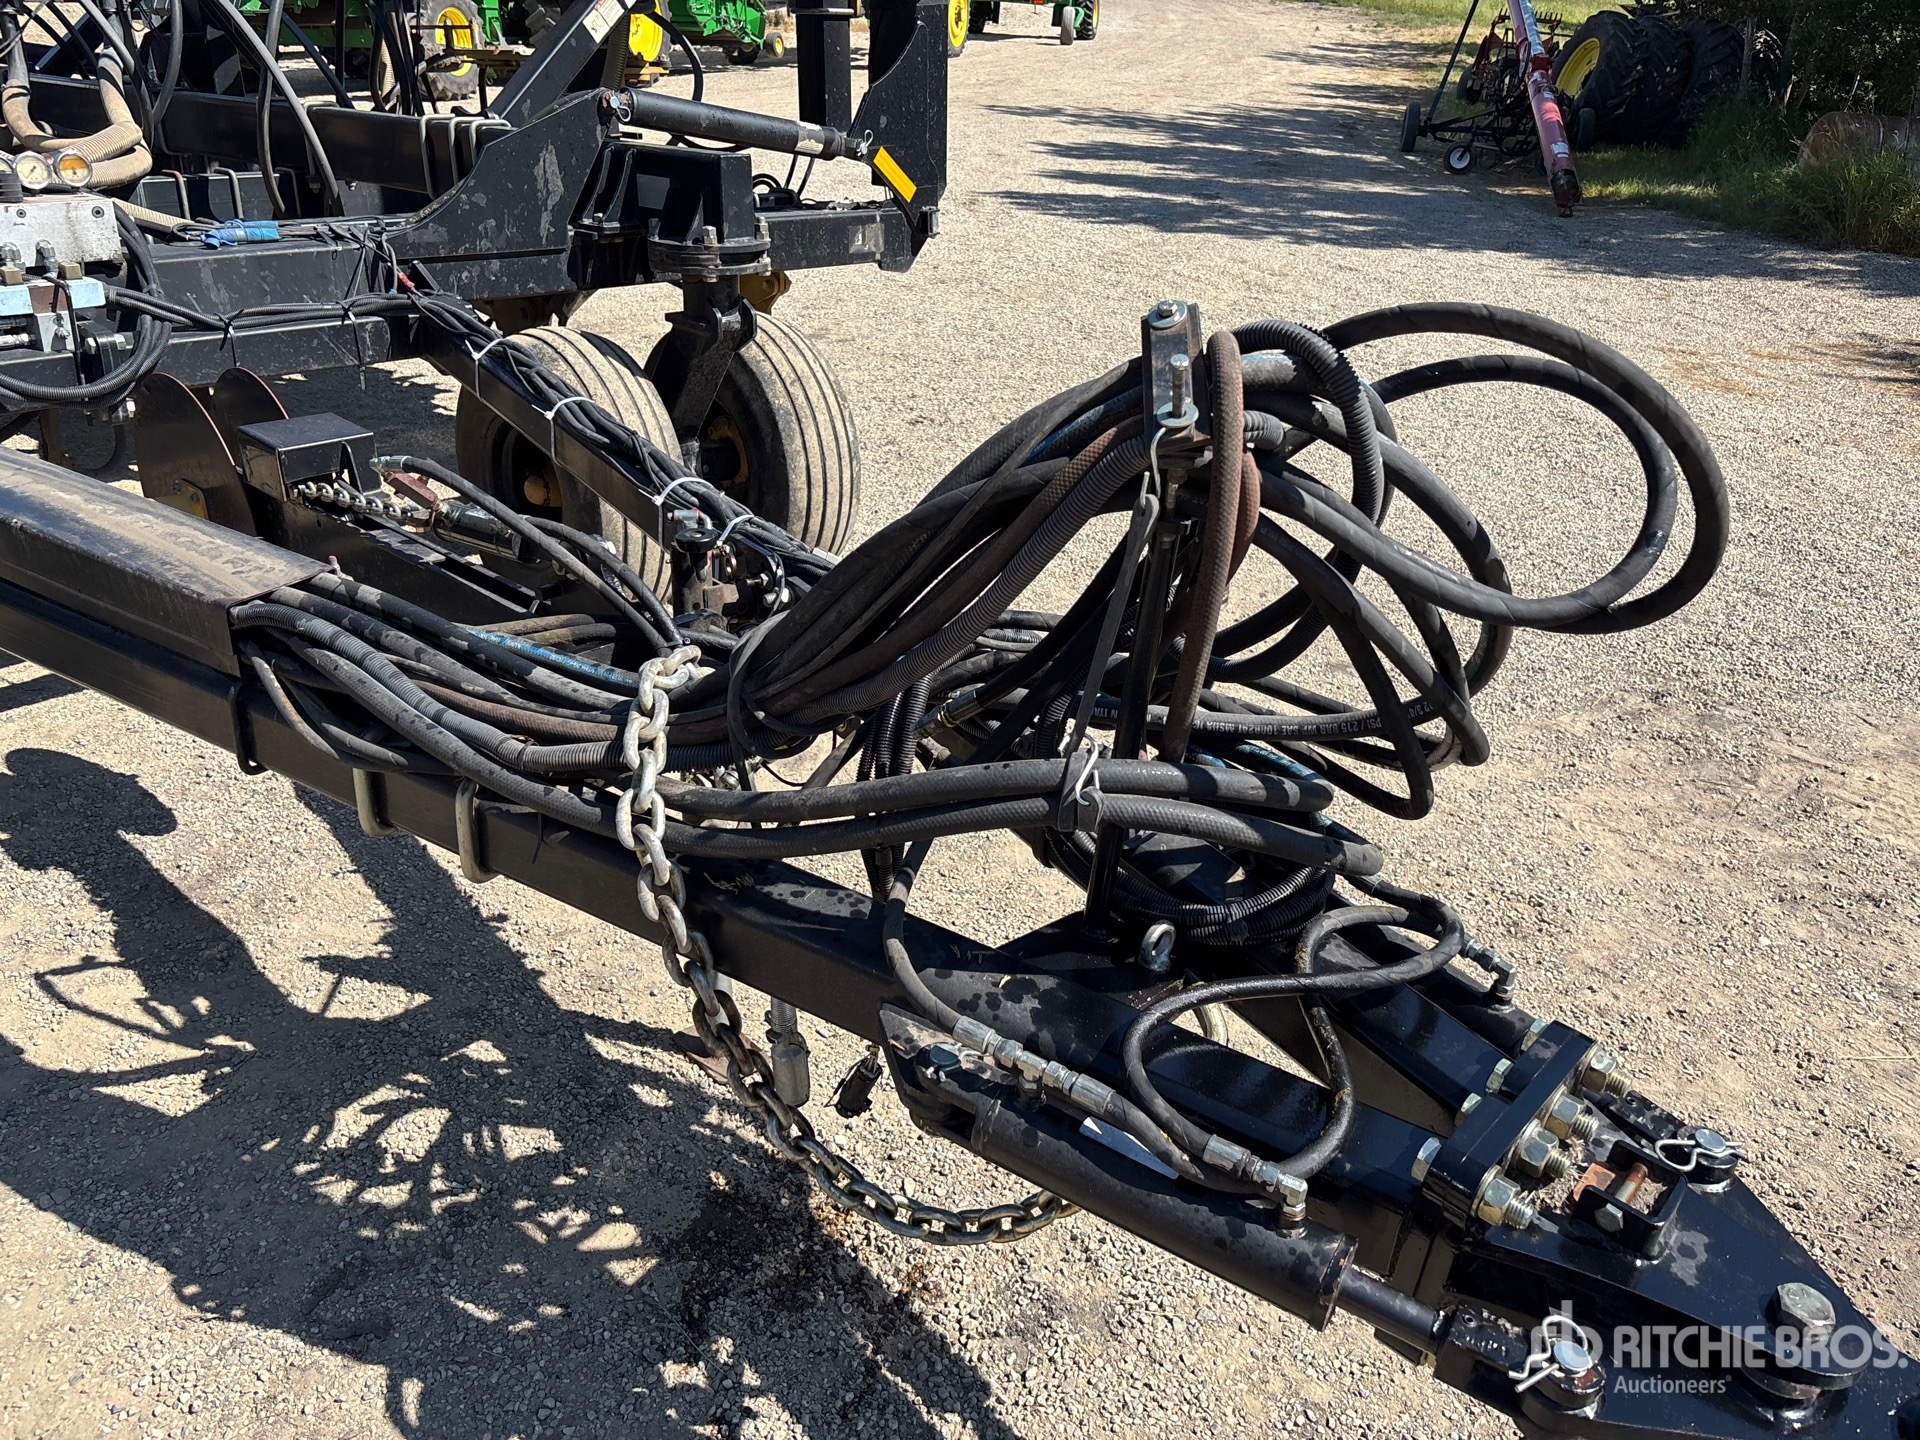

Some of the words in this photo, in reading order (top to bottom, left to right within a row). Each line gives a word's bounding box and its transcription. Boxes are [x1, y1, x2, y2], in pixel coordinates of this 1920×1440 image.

[1281, 725, 1299, 736] SAE
[1320, 723, 1339, 735] BAR
[1341, 720, 1359, 733] 215
